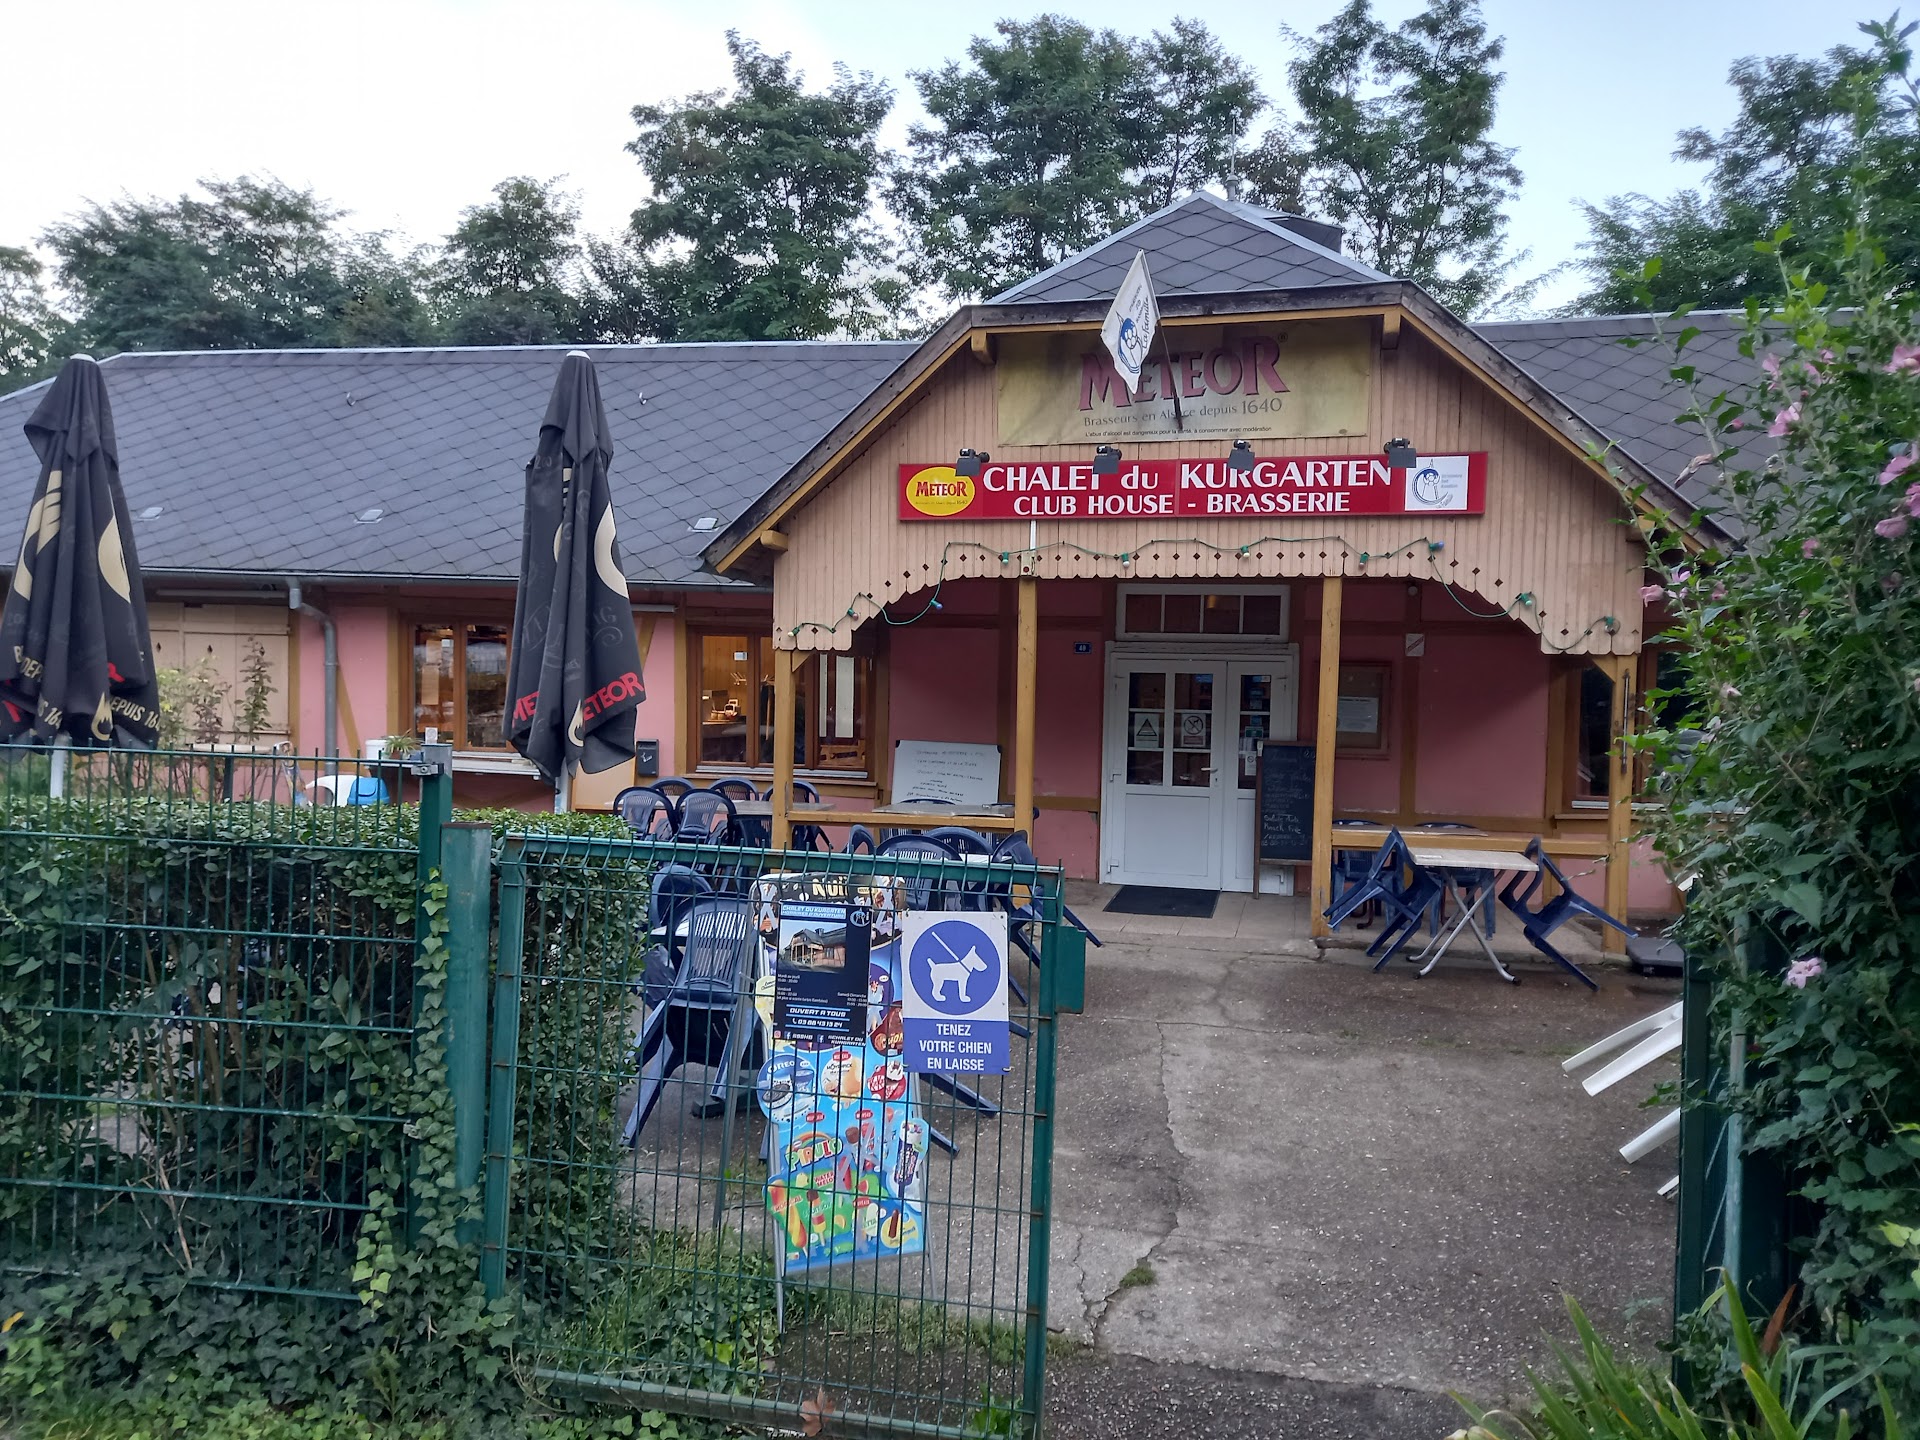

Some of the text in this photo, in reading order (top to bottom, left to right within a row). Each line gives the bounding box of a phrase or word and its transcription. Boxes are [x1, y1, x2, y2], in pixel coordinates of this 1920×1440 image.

[1078, 336, 1290, 411] METEOR
[1084, 398, 1282, 427] Brasseurs en Alsce depuis 1640
[983, 459, 1391, 491] CHALET du KURGARTEN
[915, 481, 967, 497] METEOR
[1013, 496, 1077, 516] CLUB
[1088, 494, 1174, 514] HOUSE
[1207, 491, 1350, 513] BRASSERIE
[583, 672, 645, 724] ETEOR
[936, 1024, 971, 1036] TENEZ
[919, 1040, 992, 1054] VOTRE CHIEN
[767, 1060, 795, 1073] OREO
[927, 1058, 984, 1070] EN LAISSE
